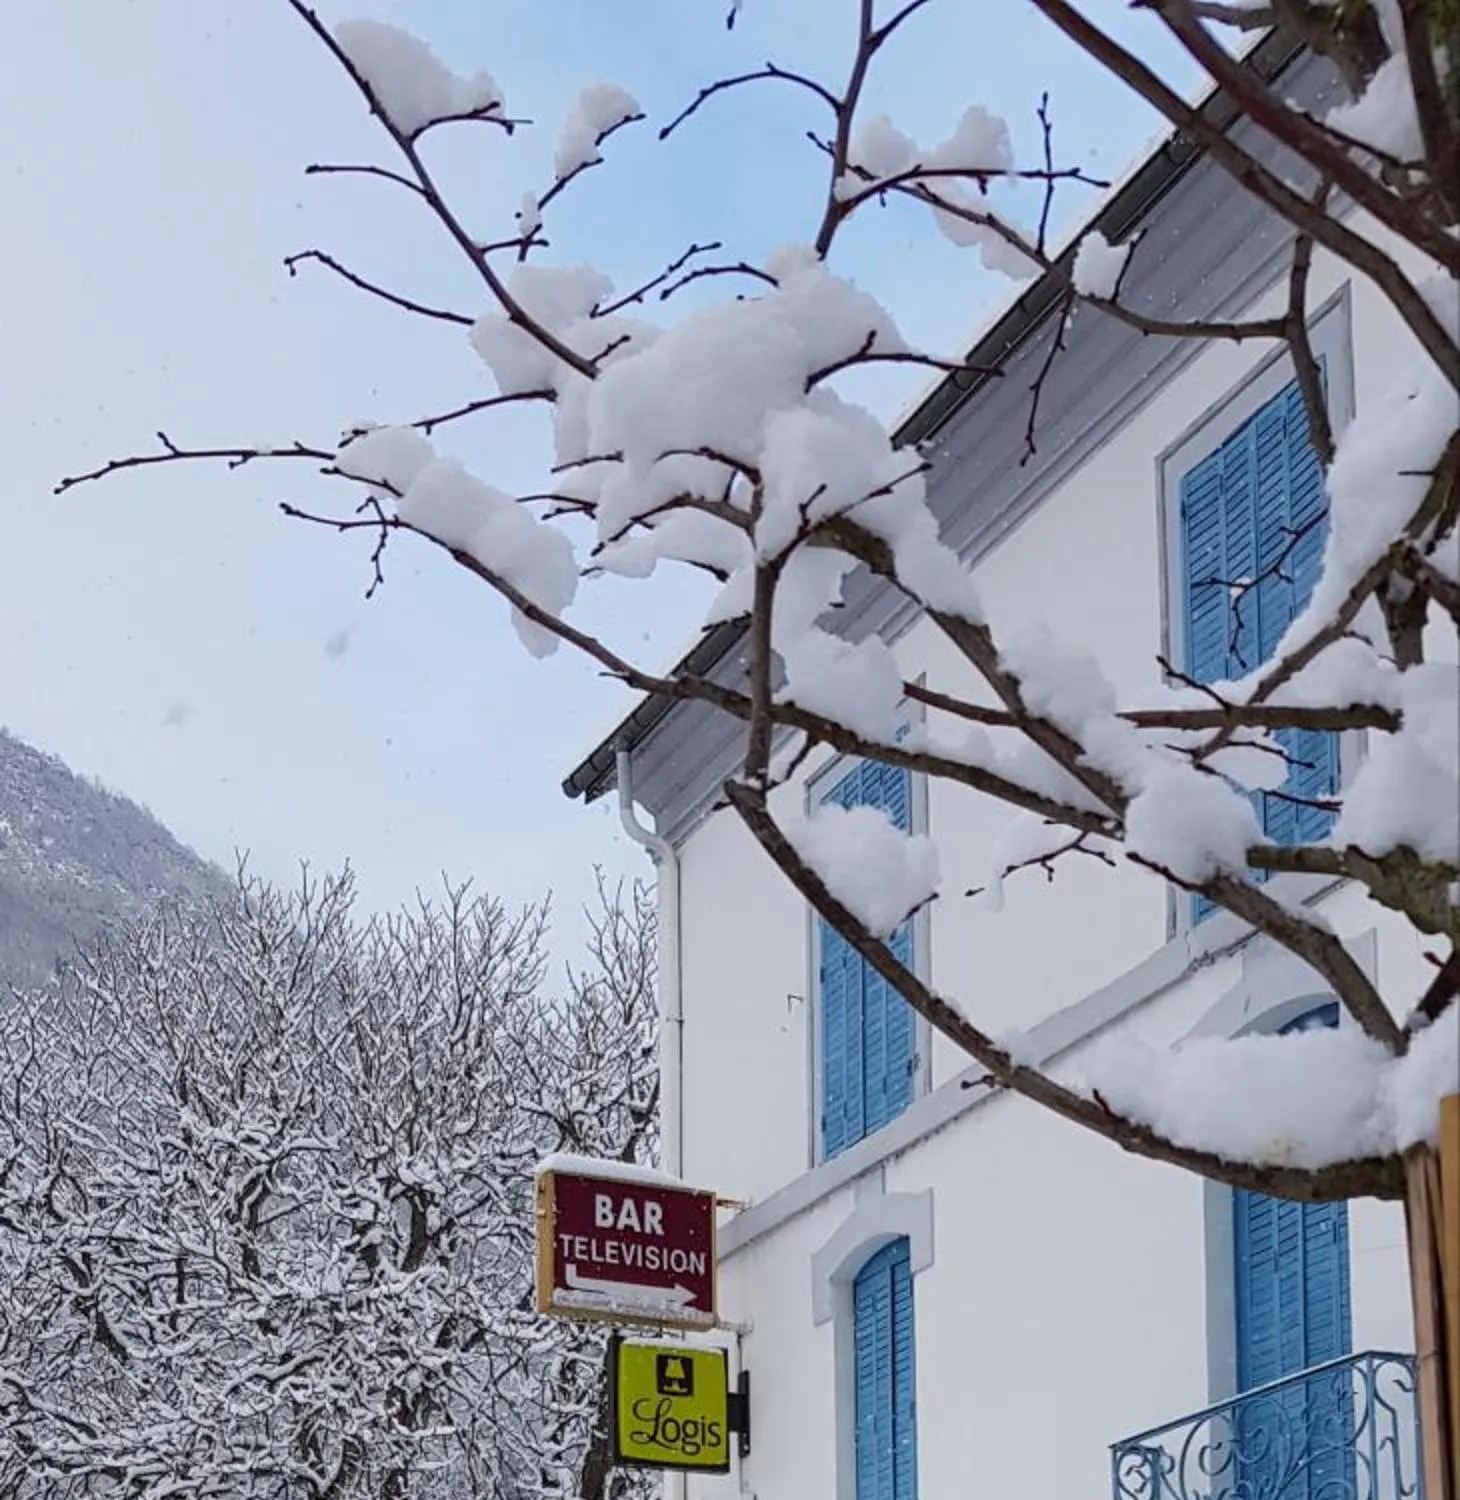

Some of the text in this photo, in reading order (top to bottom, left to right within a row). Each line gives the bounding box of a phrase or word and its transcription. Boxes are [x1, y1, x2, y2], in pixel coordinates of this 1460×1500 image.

[594, 1194, 665, 1236] BAR
[559, 1233, 707, 1275] TELEVISION
[630, 1397, 721, 1456] Logis
